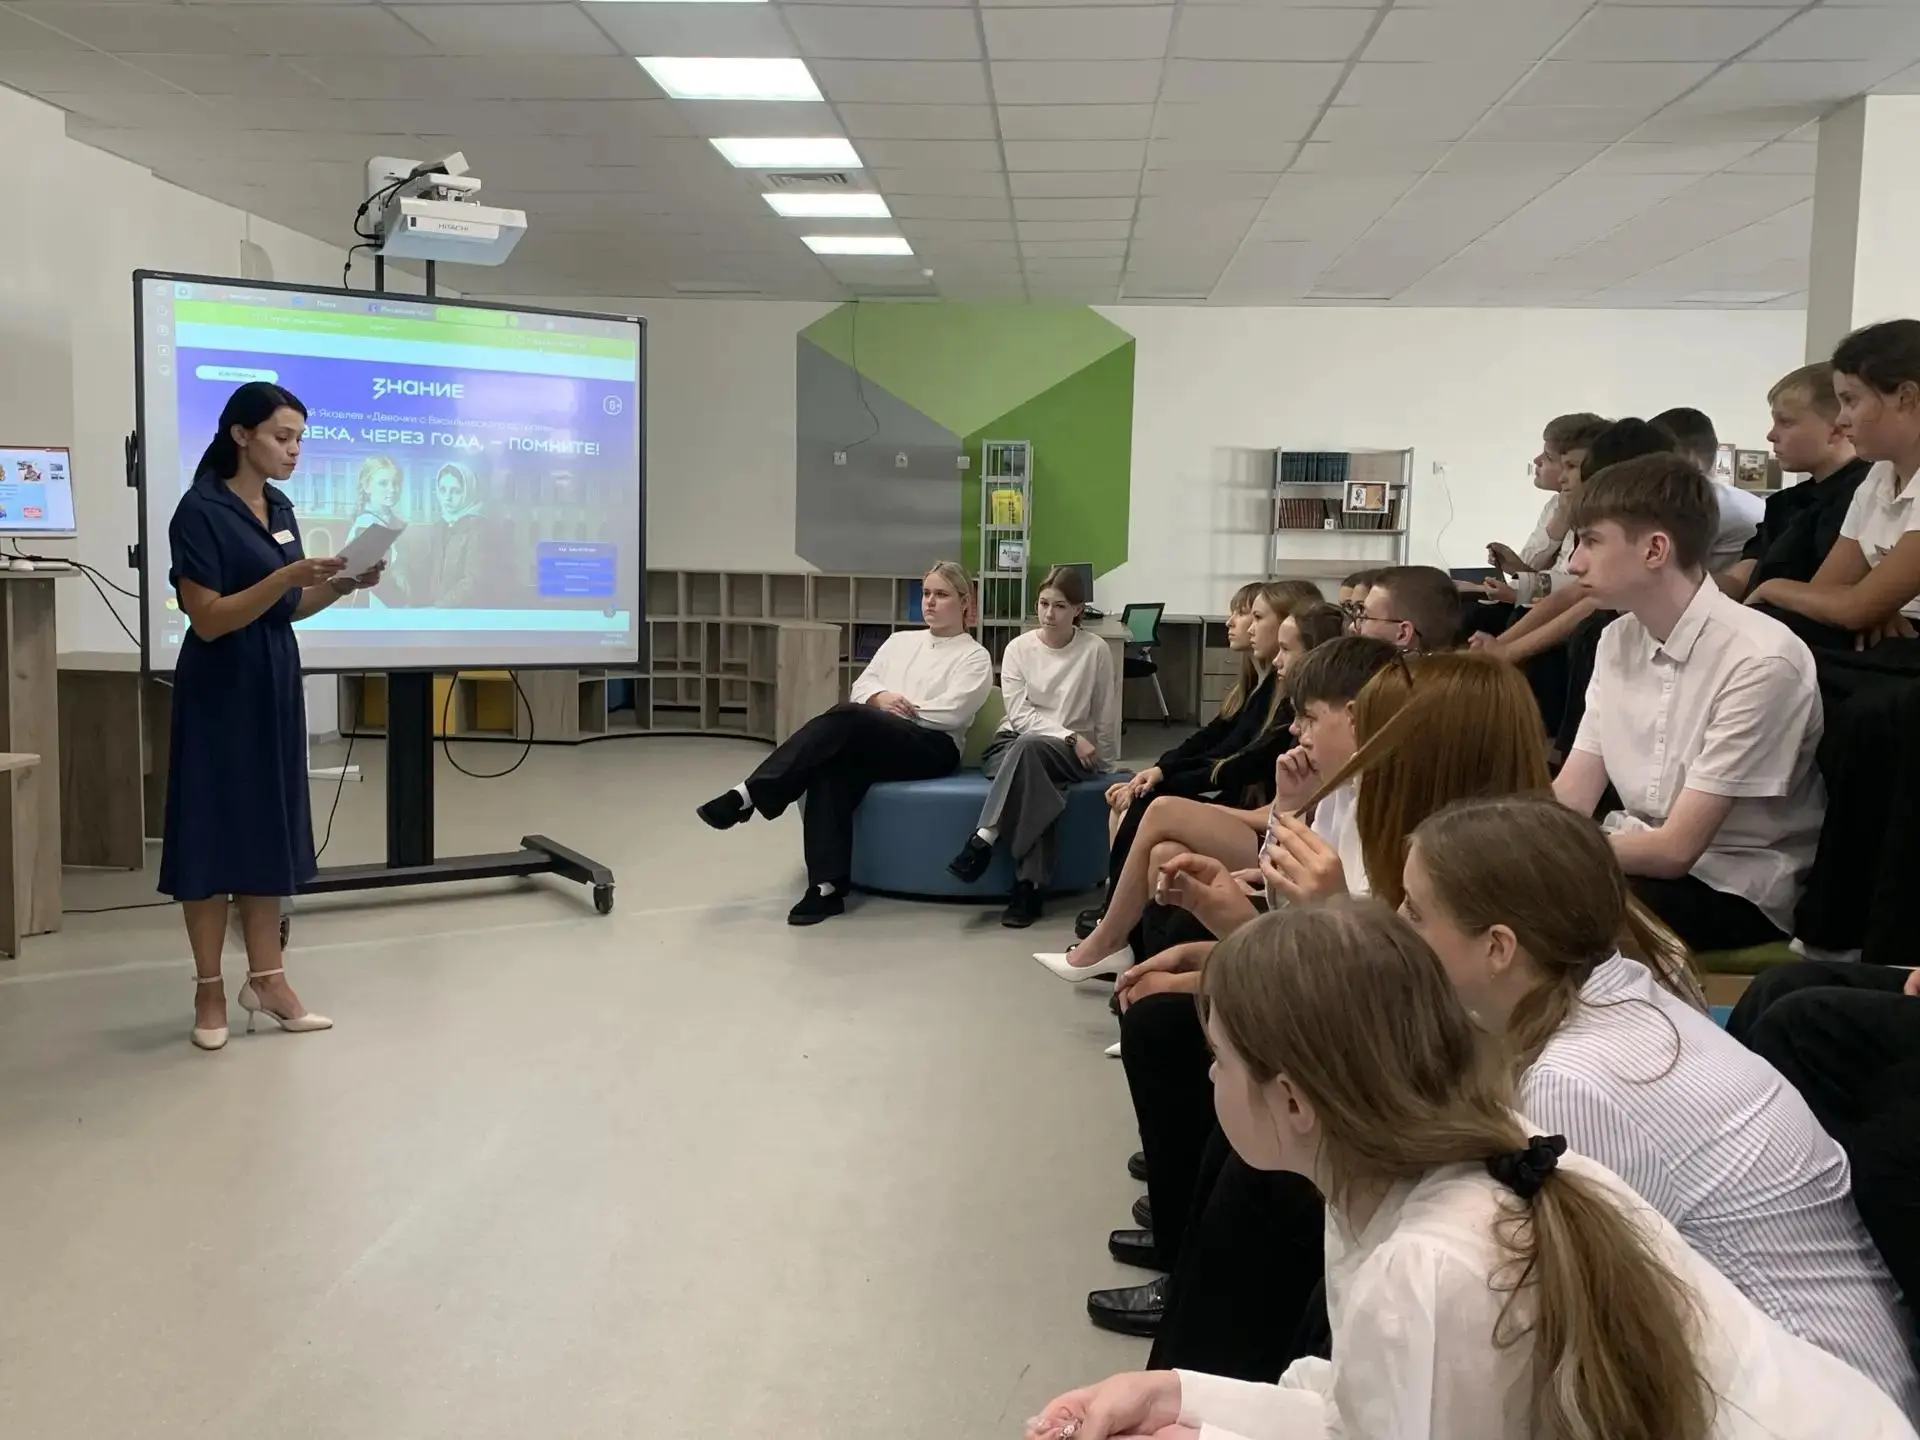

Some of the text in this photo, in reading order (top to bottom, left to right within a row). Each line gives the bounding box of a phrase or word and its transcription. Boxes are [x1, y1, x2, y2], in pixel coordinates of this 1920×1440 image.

[438, 222, 469, 232] HITACHI
[319, 408, 363, 420] Яковлев
[361, 428, 424, 445] ЧЕРЕЗ
[431, 432, 484, 451] ГОДА,
[509, 436, 600, 456] ПОМНИТЕ!
